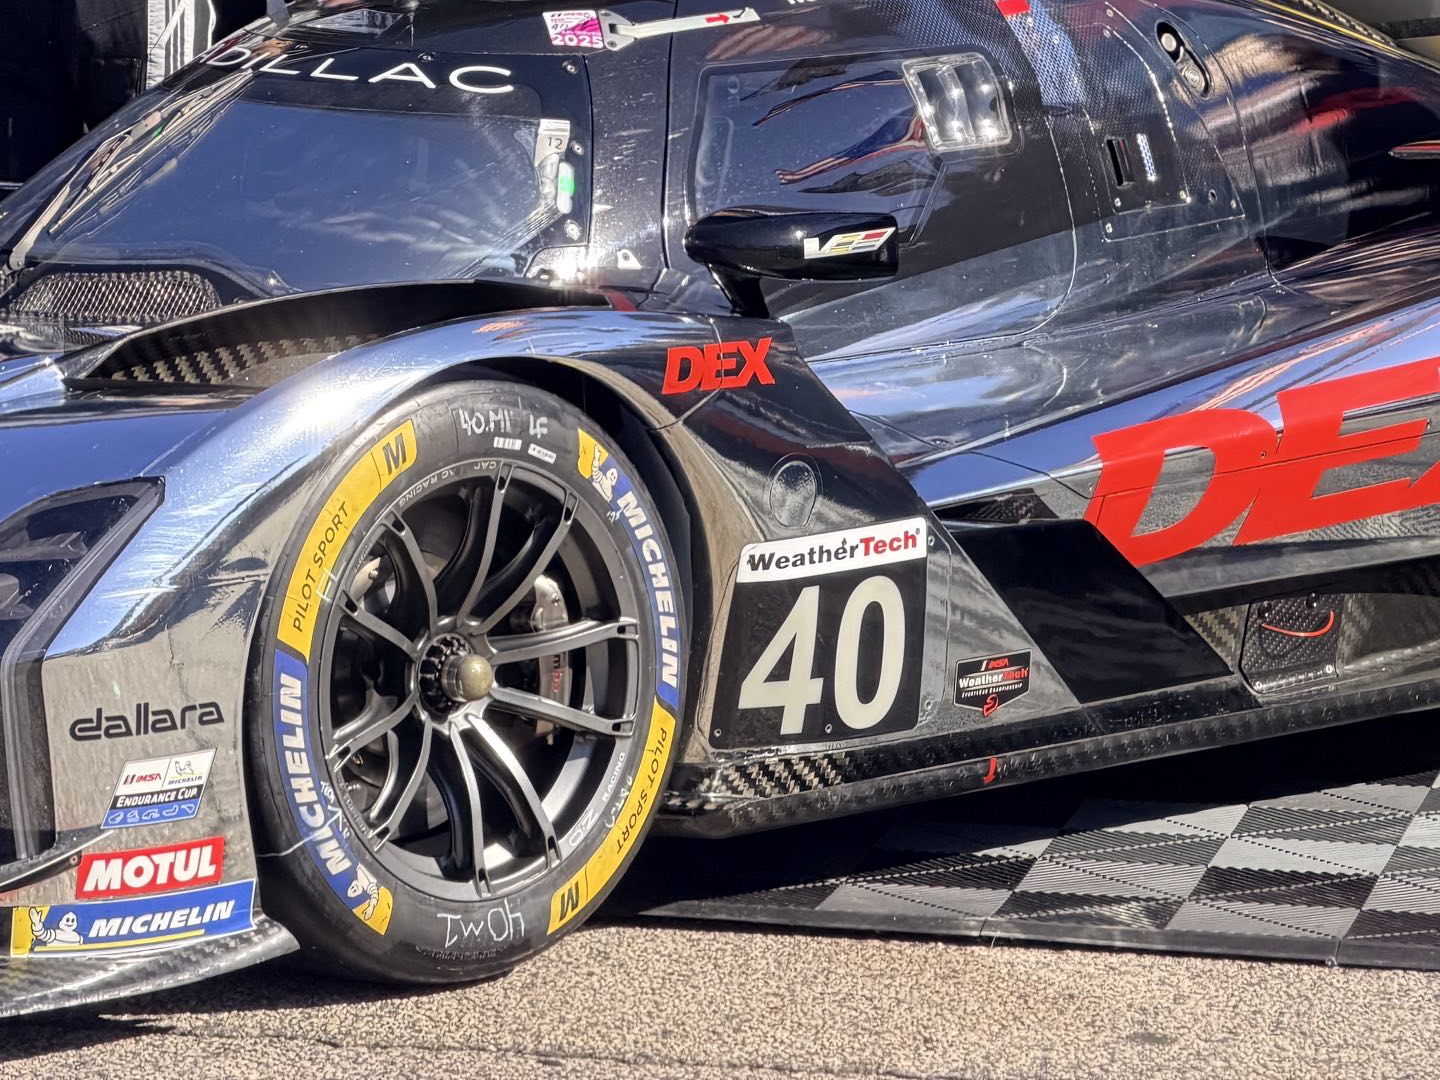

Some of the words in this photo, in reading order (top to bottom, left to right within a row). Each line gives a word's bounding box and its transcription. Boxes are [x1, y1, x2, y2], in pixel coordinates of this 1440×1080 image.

[551, 34, 603, 48] 2025
[206, 47, 514, 94] DILLAC
[547, 136, 563, 150] 12
[663, 337, 775, 395] DEX
[382, 432, 407, 476] M
[1083, 357, 1440, 569] DE
[292, 568, 318, 633] PILOT
[313, 501, 350, 569] SPORT
[746, 529, 920, 572] WeatherTech
[617, 490, 678, 688] MICHELIN
[739, 575, 906, 735] 40
[959, 668, 1029, 689] WeatherTech
[69, 701, 225, 741] dallara
[135, 772, 162, 783] IMSA
[279, 673, 353, 876] MICHELIN
[601, 751, 626, 802] RACING
[647, 727, 667, 789] PILOT
[116, 790, 177, 808] ENDURANCE
[617, 789, 649, 854] SPORT
[83, 845, 217, 892] MOTUL
[88, 900, 235, 938] MICHELIN
